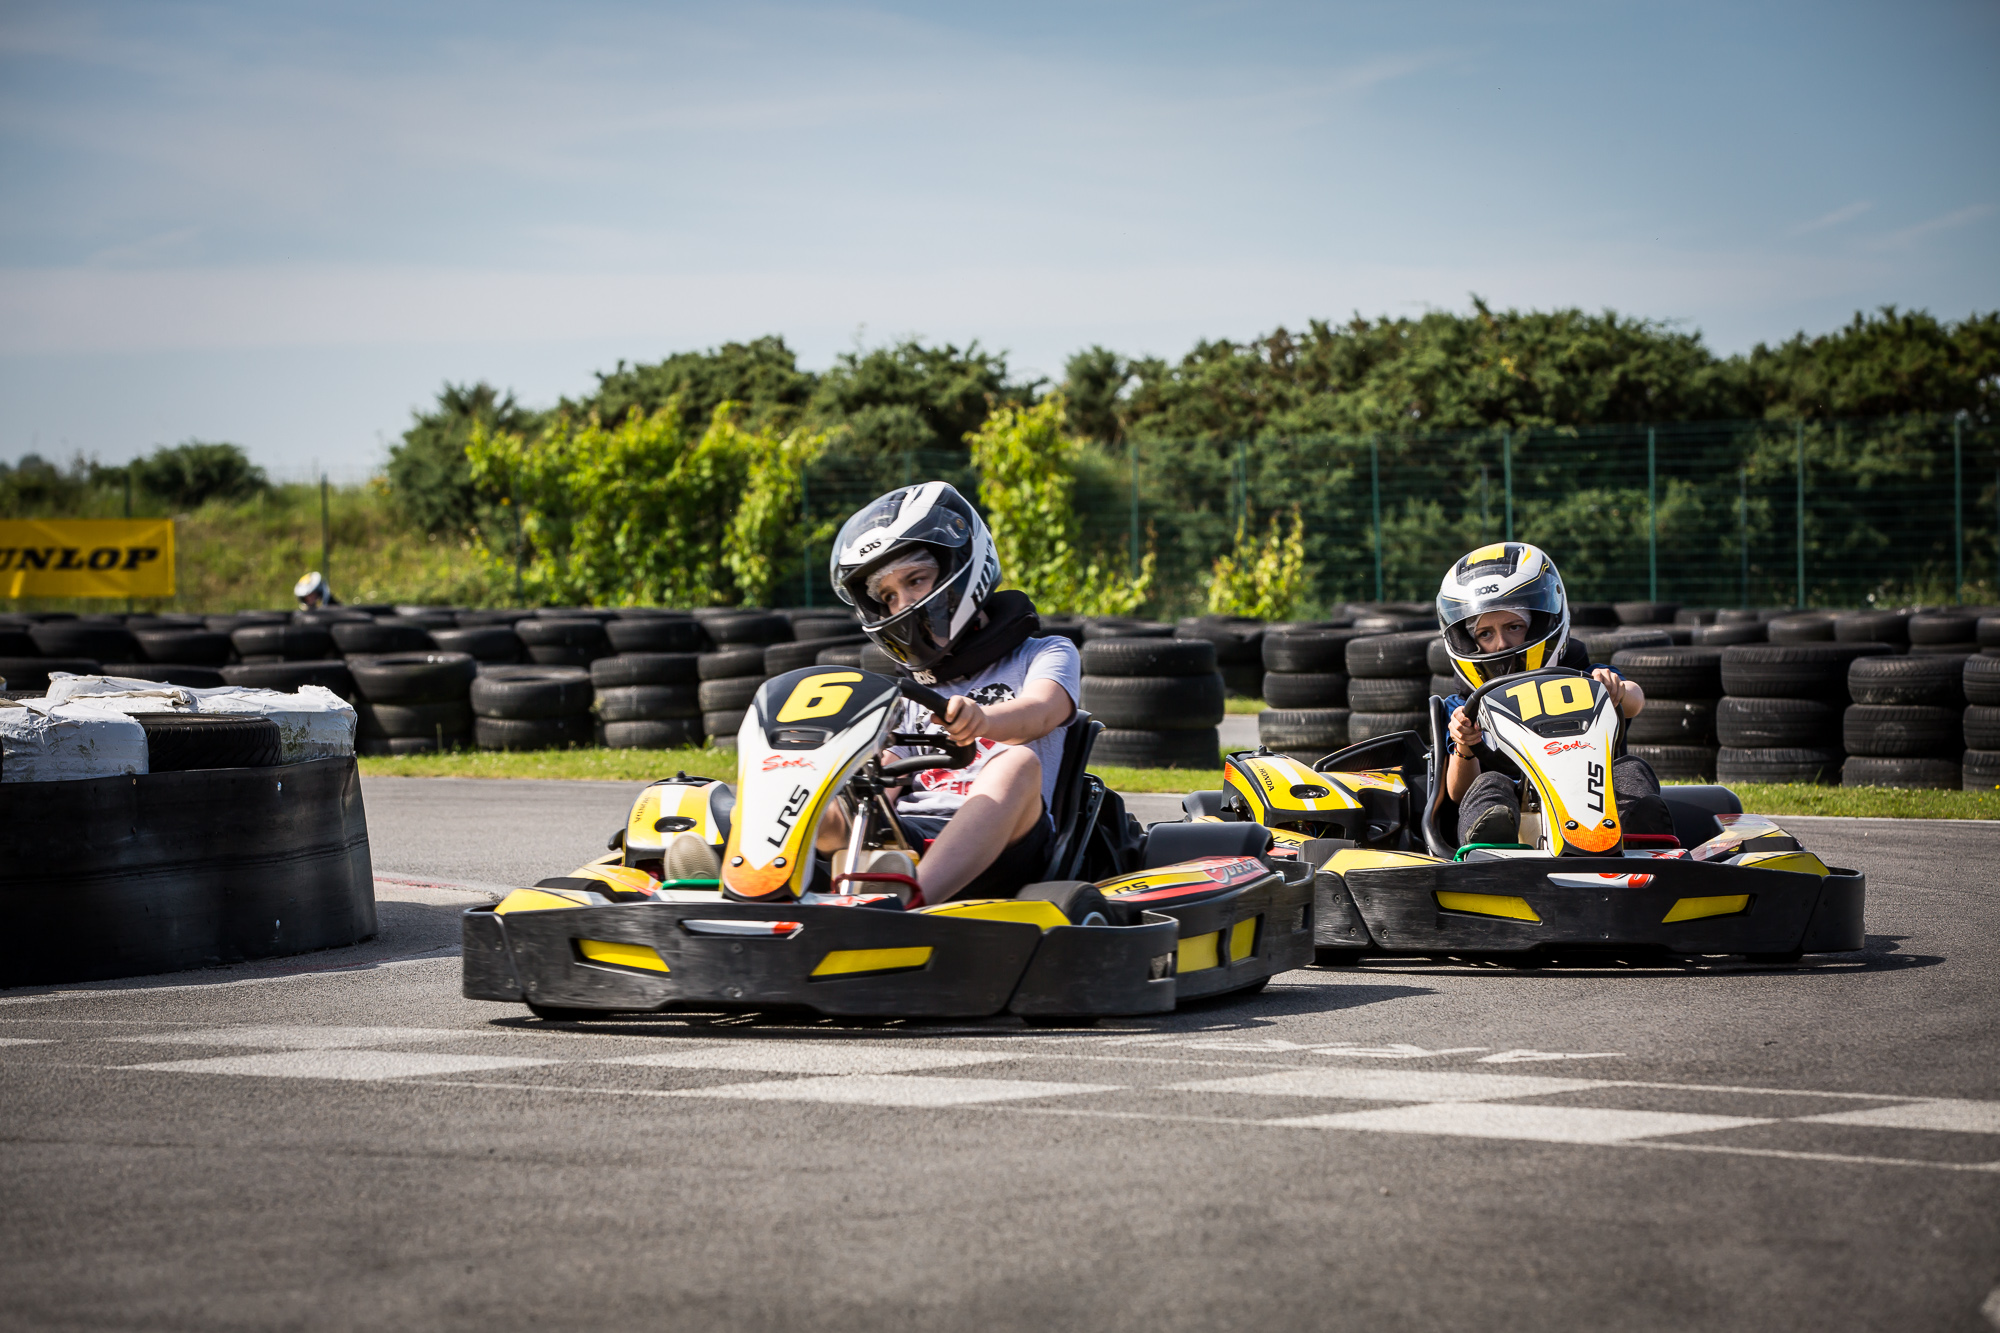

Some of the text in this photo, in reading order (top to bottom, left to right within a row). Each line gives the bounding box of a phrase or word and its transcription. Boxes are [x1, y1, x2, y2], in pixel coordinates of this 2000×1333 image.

[776, 671, 864, 723] 6
[1505, 677, 1595, 723] 10
[1258, 767, 1275, 792] HONDA
[1587, 761, 1604, 814] LRS
[767, 784, 810, 848] LRS
